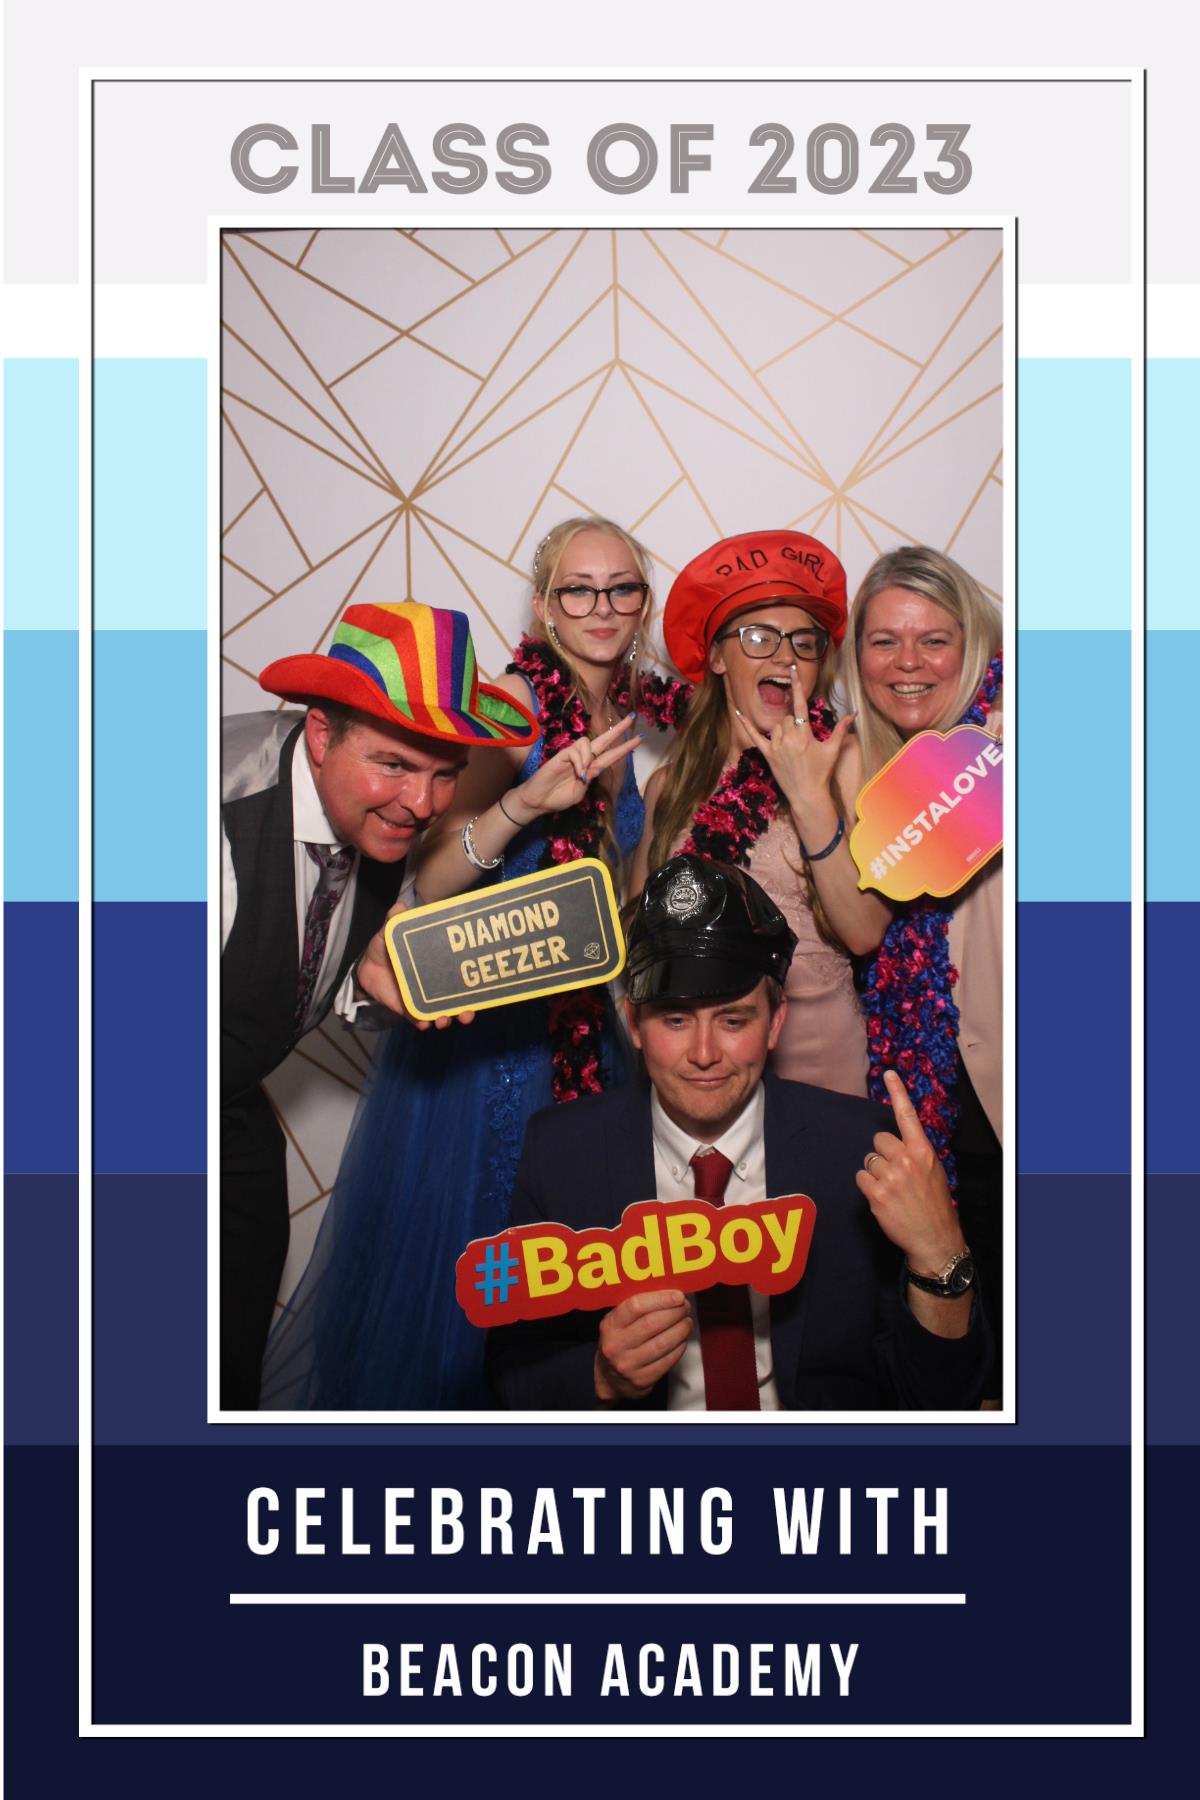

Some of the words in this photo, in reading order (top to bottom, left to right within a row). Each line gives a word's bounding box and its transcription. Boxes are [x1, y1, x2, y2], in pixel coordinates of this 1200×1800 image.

[781, 547, 825, 583] GIRL
[870, 743, 1003, 880] #INSTALOVE
[446, 900, 560, 953] DIAMOND
[460, 935, 570, 988] GEEZER
[475, 1208, 803, 1305] #BadBoy
